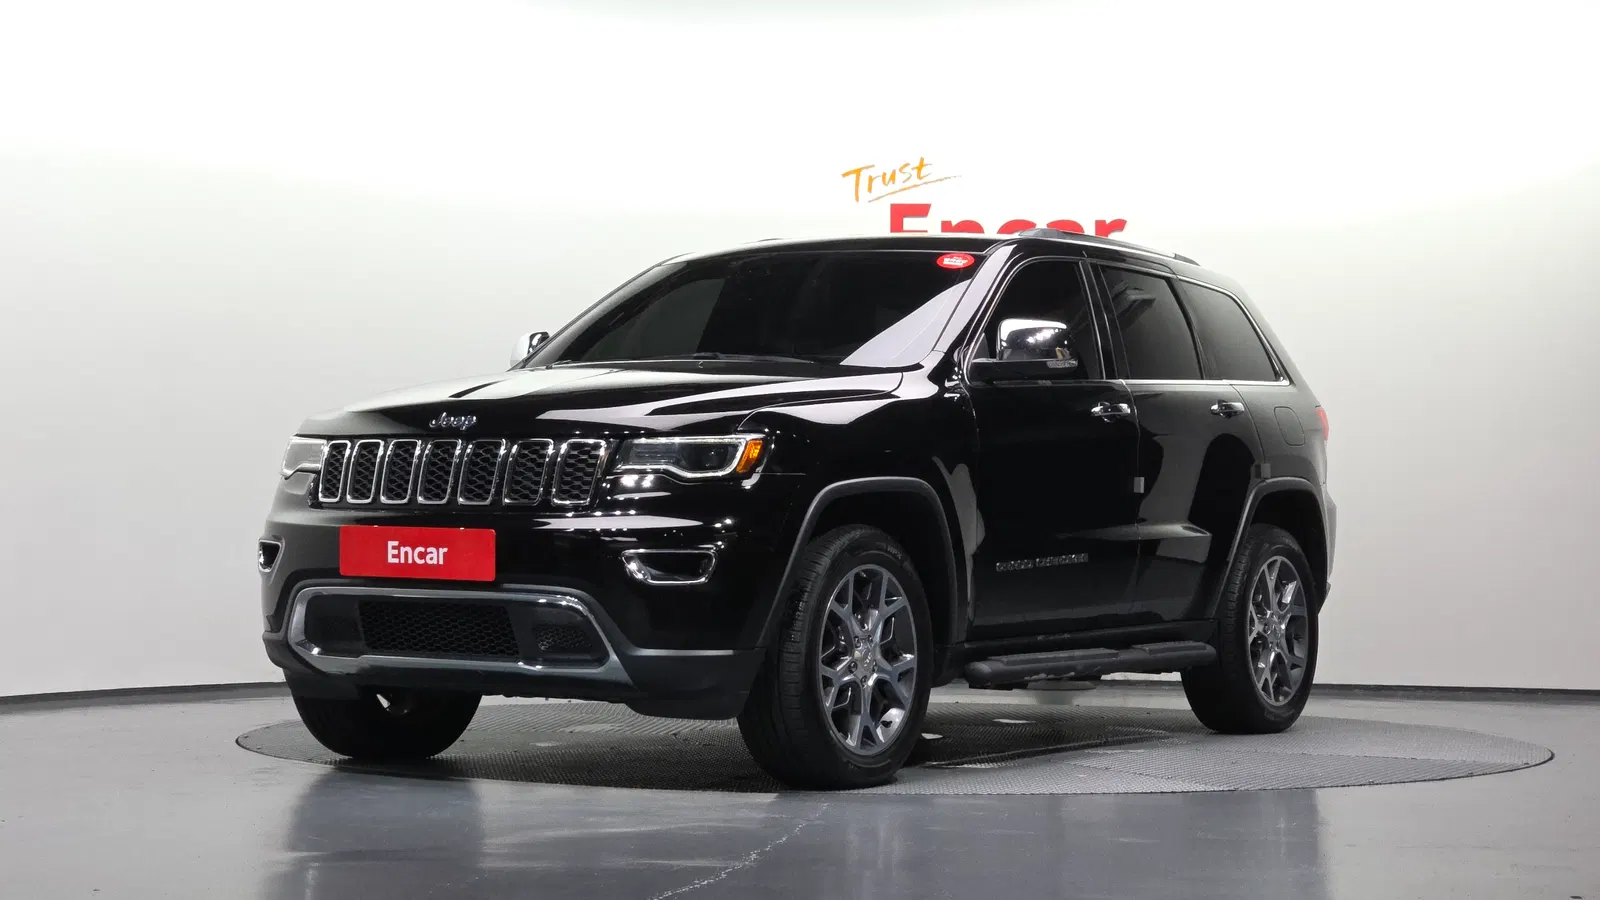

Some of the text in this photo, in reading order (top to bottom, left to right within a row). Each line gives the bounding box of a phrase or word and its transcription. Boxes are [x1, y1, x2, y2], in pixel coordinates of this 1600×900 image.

[842, 157, 933, 202] Trust
[429, 412, 476, 430] Jeep
[387, 540, 448, 565] Encar
